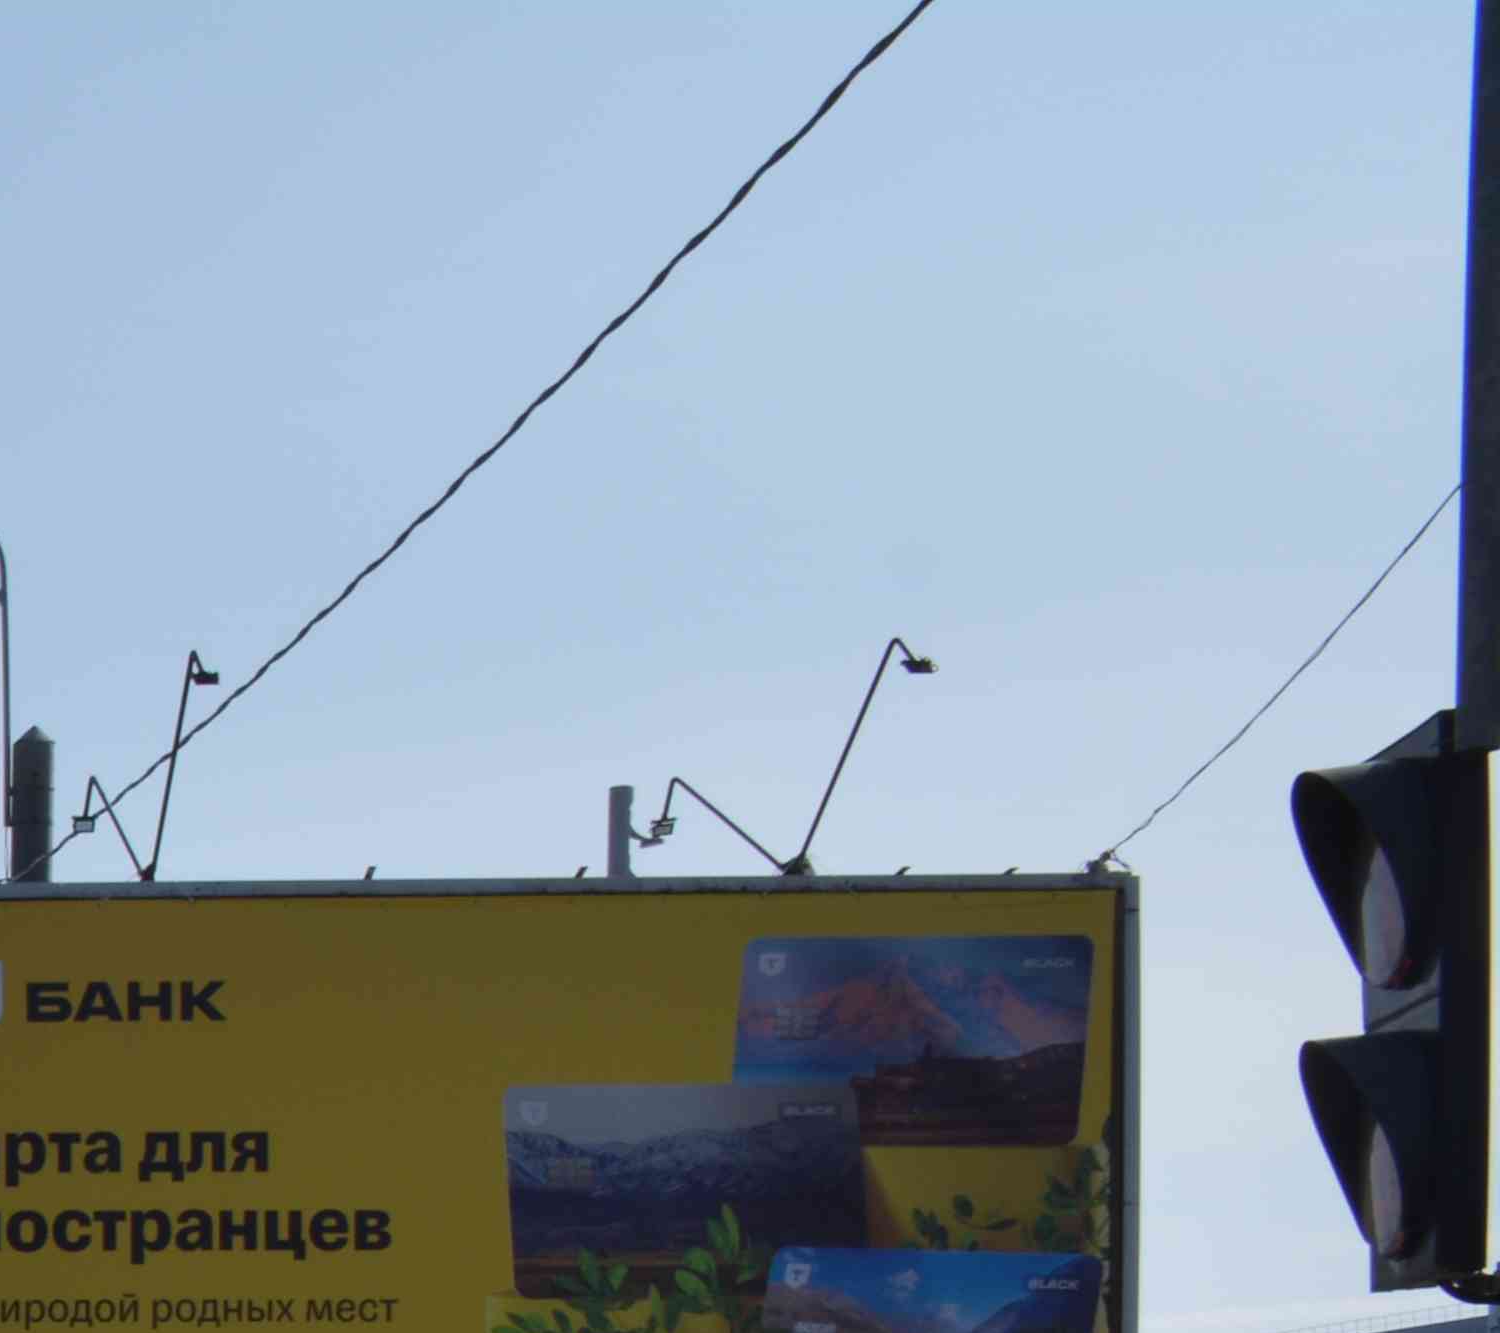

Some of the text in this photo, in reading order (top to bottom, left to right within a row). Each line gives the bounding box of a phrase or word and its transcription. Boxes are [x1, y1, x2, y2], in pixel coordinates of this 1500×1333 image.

[26, 981, 226, 1022] БАНК
[138, 1129, 270, 1183] для
[151, 1296, 294, 1331] родных
[306, 1298, 398, 1323] мест
